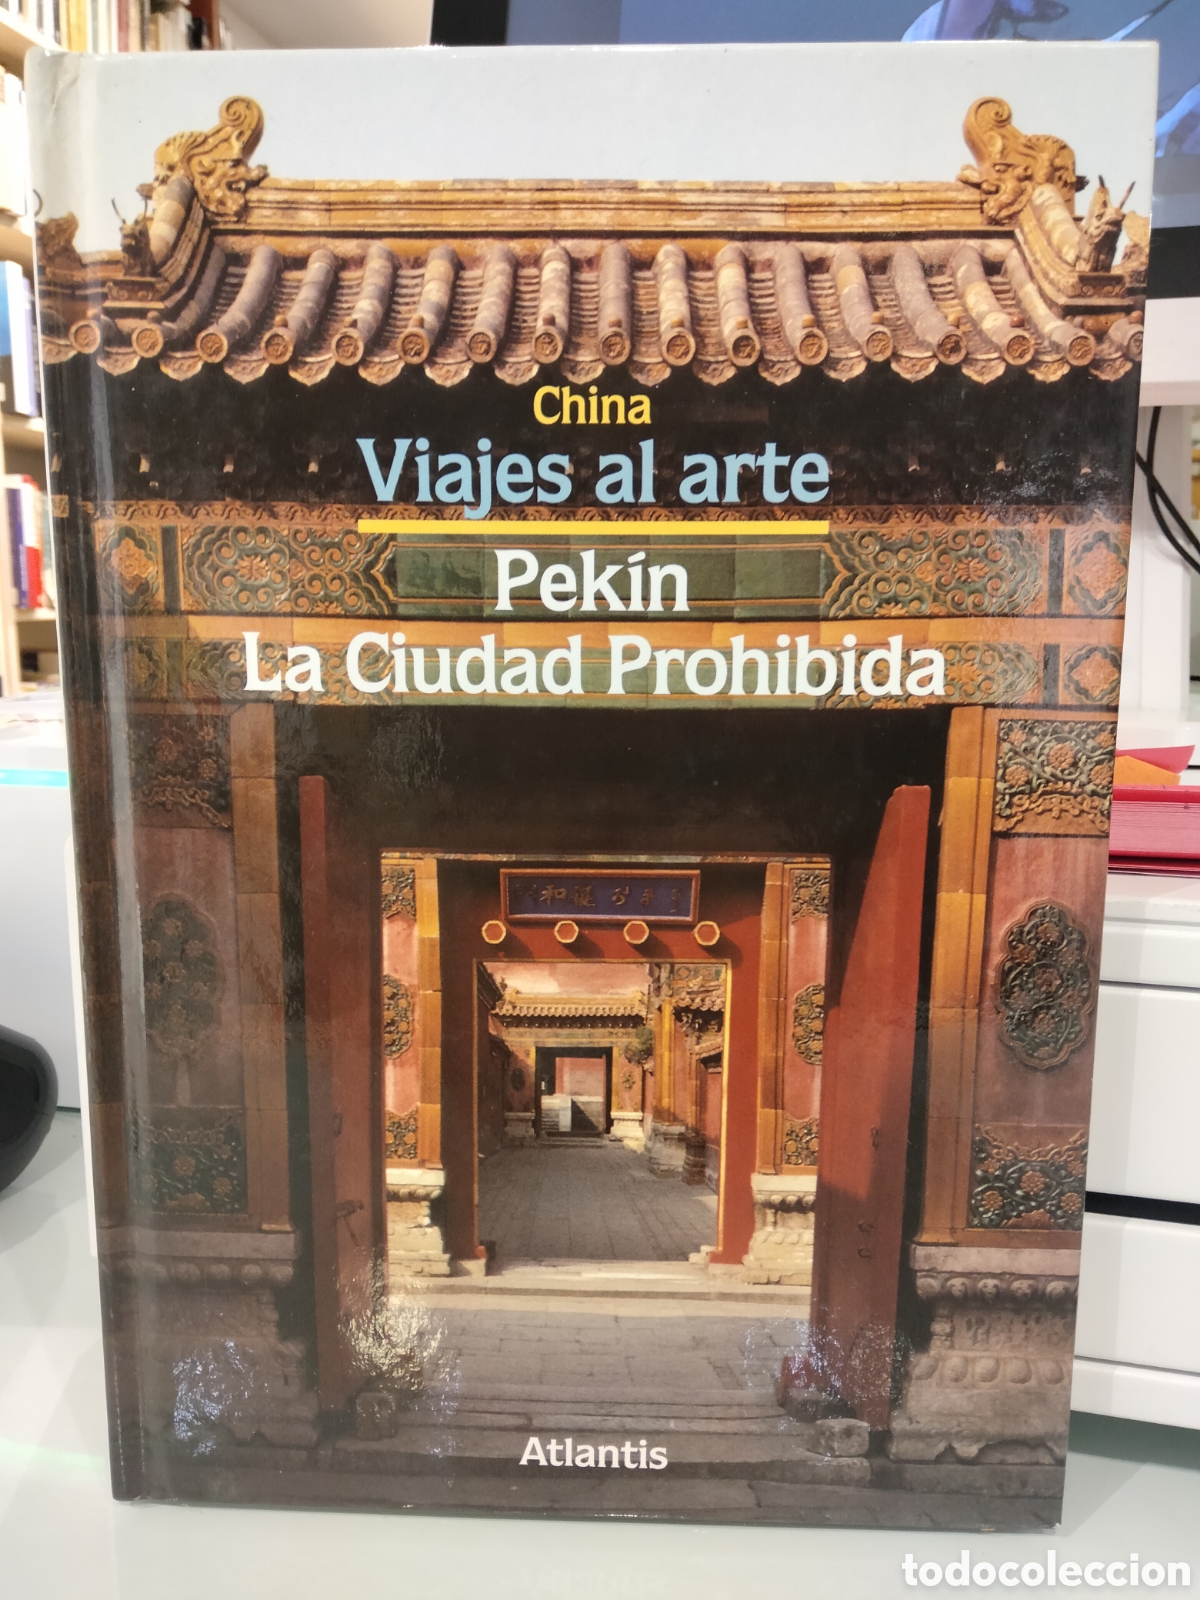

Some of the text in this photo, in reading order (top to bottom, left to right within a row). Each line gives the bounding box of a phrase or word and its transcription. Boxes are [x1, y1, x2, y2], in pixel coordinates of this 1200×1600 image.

[533, 386, 652, 425] China
[356, 438, 830, 519] Viajes al arte
[494, 549, 690, 612] Pekín
[242, 631, 946, 697] La Ciudad Prohibida
[519, 1437, 669, 1470] Atlantis
